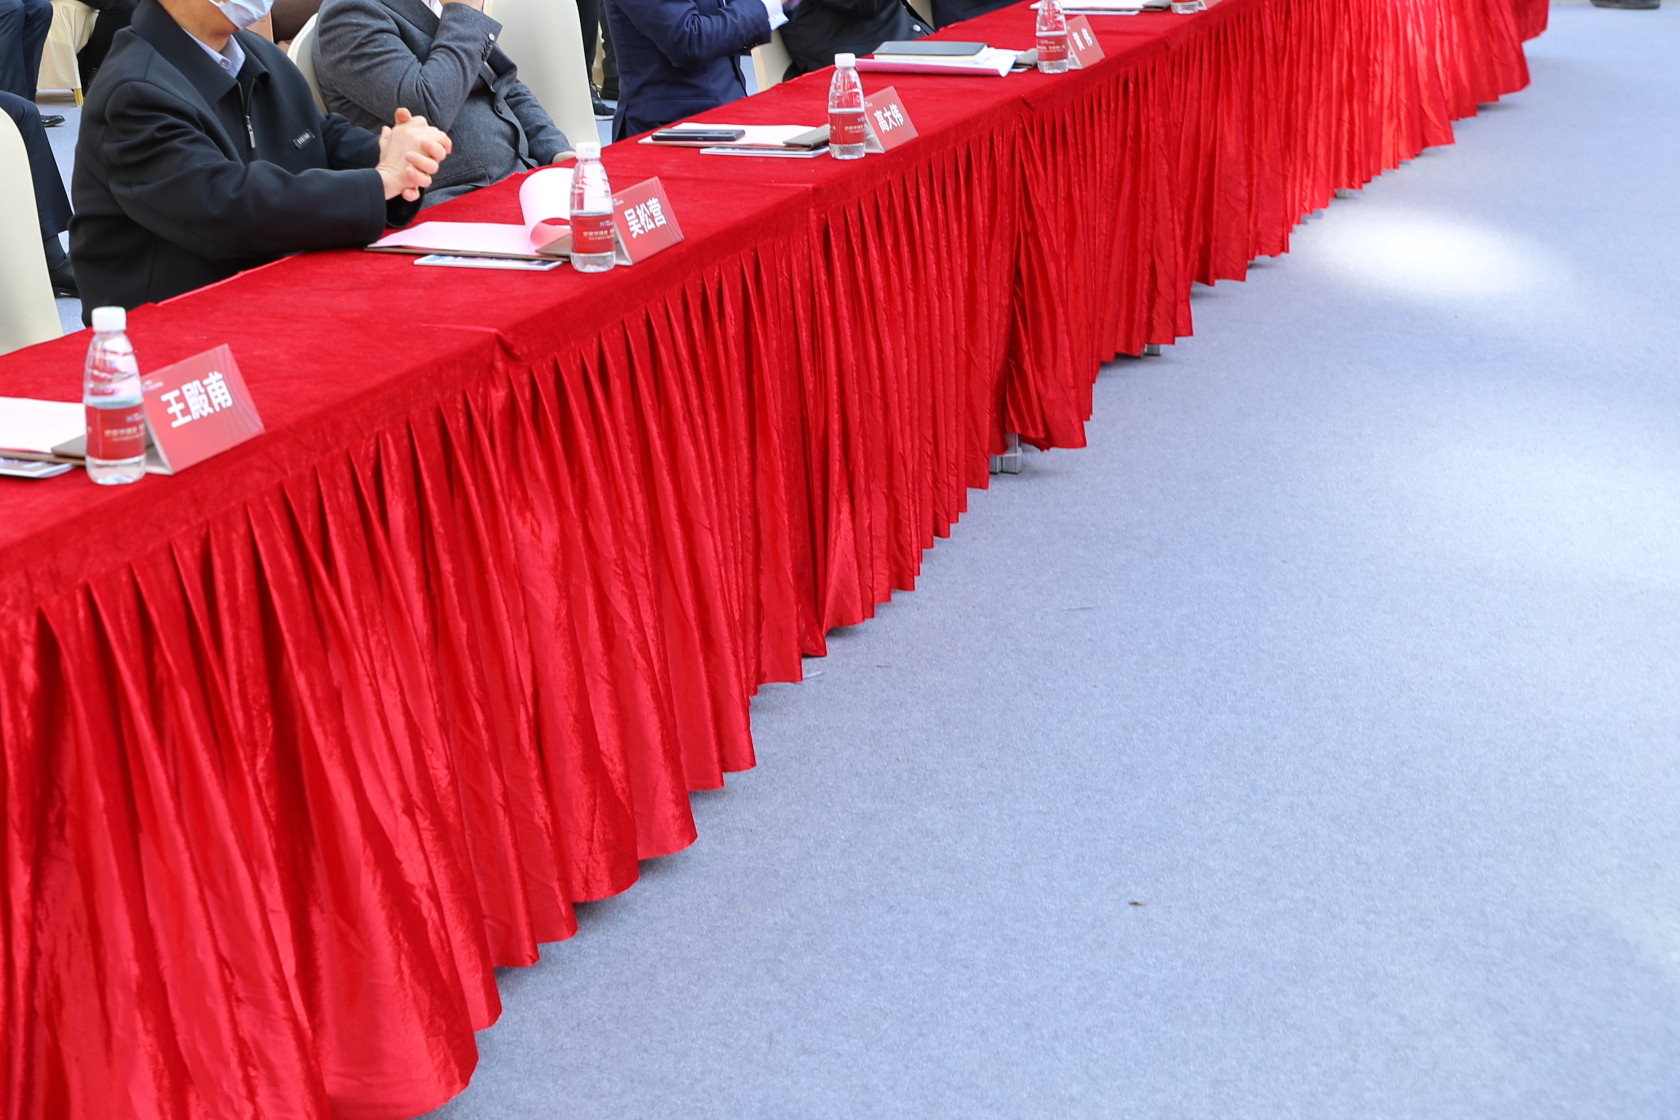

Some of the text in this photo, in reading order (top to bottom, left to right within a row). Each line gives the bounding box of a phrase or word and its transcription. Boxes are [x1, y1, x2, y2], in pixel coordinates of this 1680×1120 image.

[874, 102, 904, 134] 高大伟
[623, 196, 667, 239] 吴松营
[160, 370, 234, 429] 王殿甫
